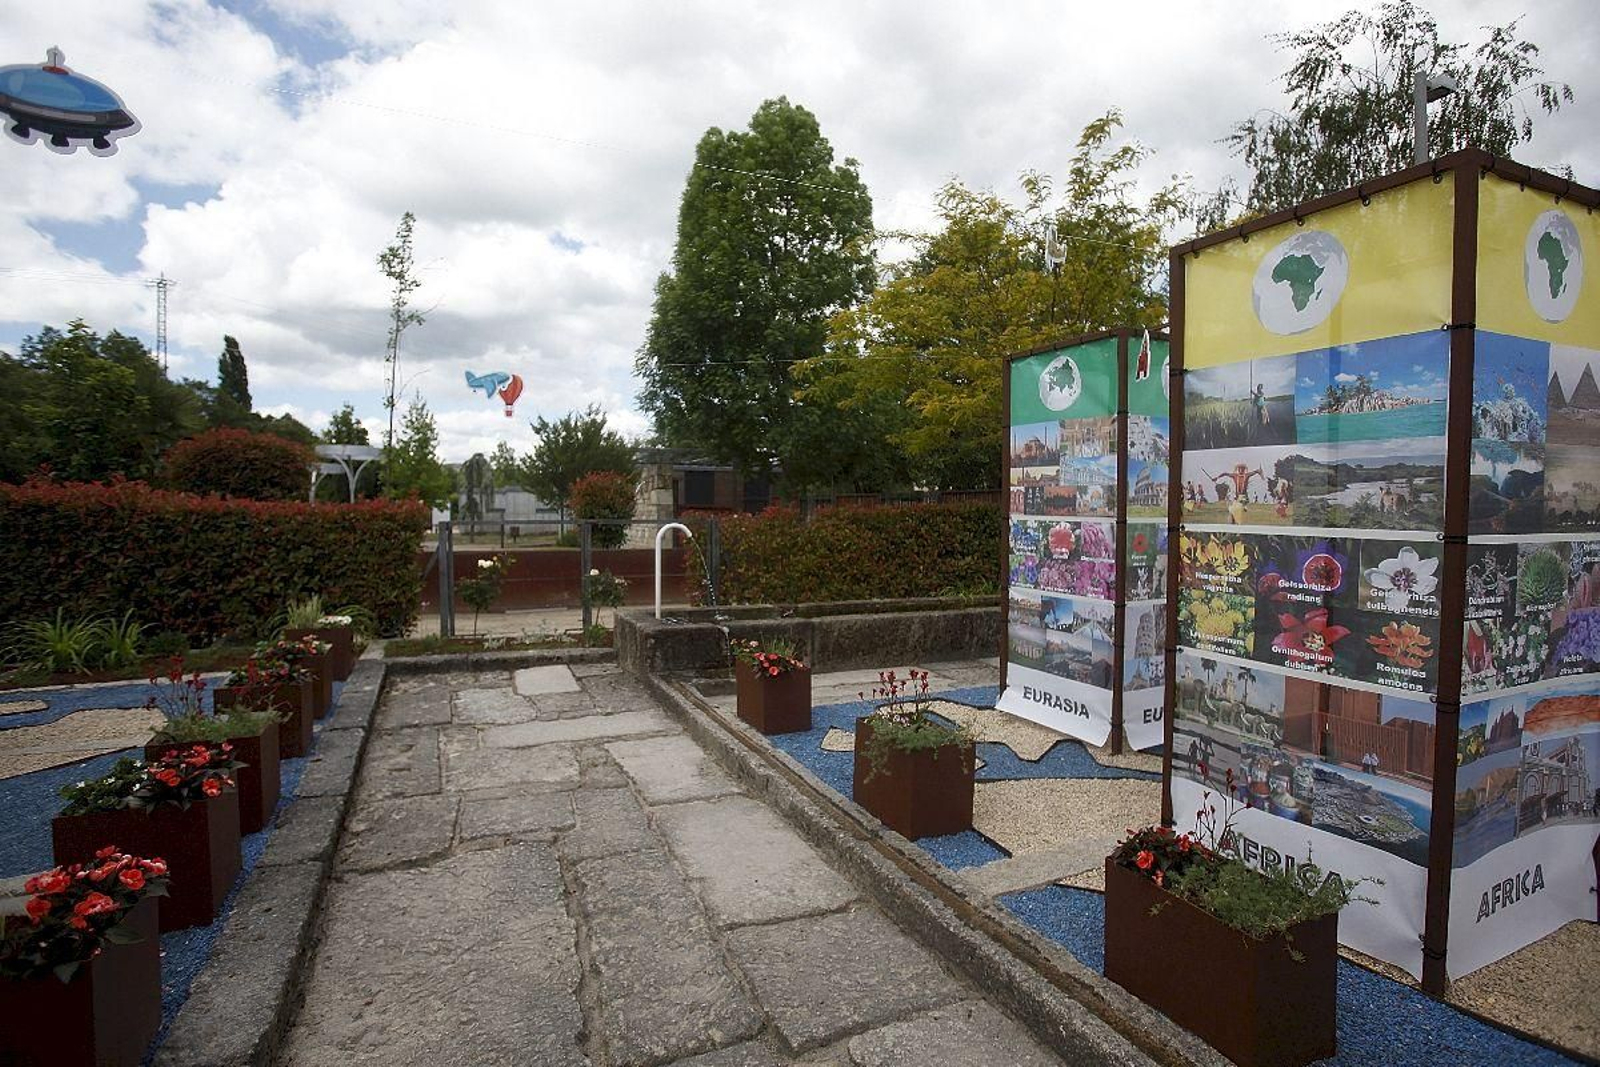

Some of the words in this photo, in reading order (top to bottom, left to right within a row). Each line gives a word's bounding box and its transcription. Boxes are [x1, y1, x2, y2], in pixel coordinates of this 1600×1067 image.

[1370, 588, 1437, 602] Geirhiza
[1271, 645, 1333, 663] Ornithogalum
[1022, 685, 1090, 720] EURASIA
[1143, 706, 1164, 724] EU
[1217, 829, 1346, 898] AFRICA
[1476, 864, 1545, 923] AFRICA
